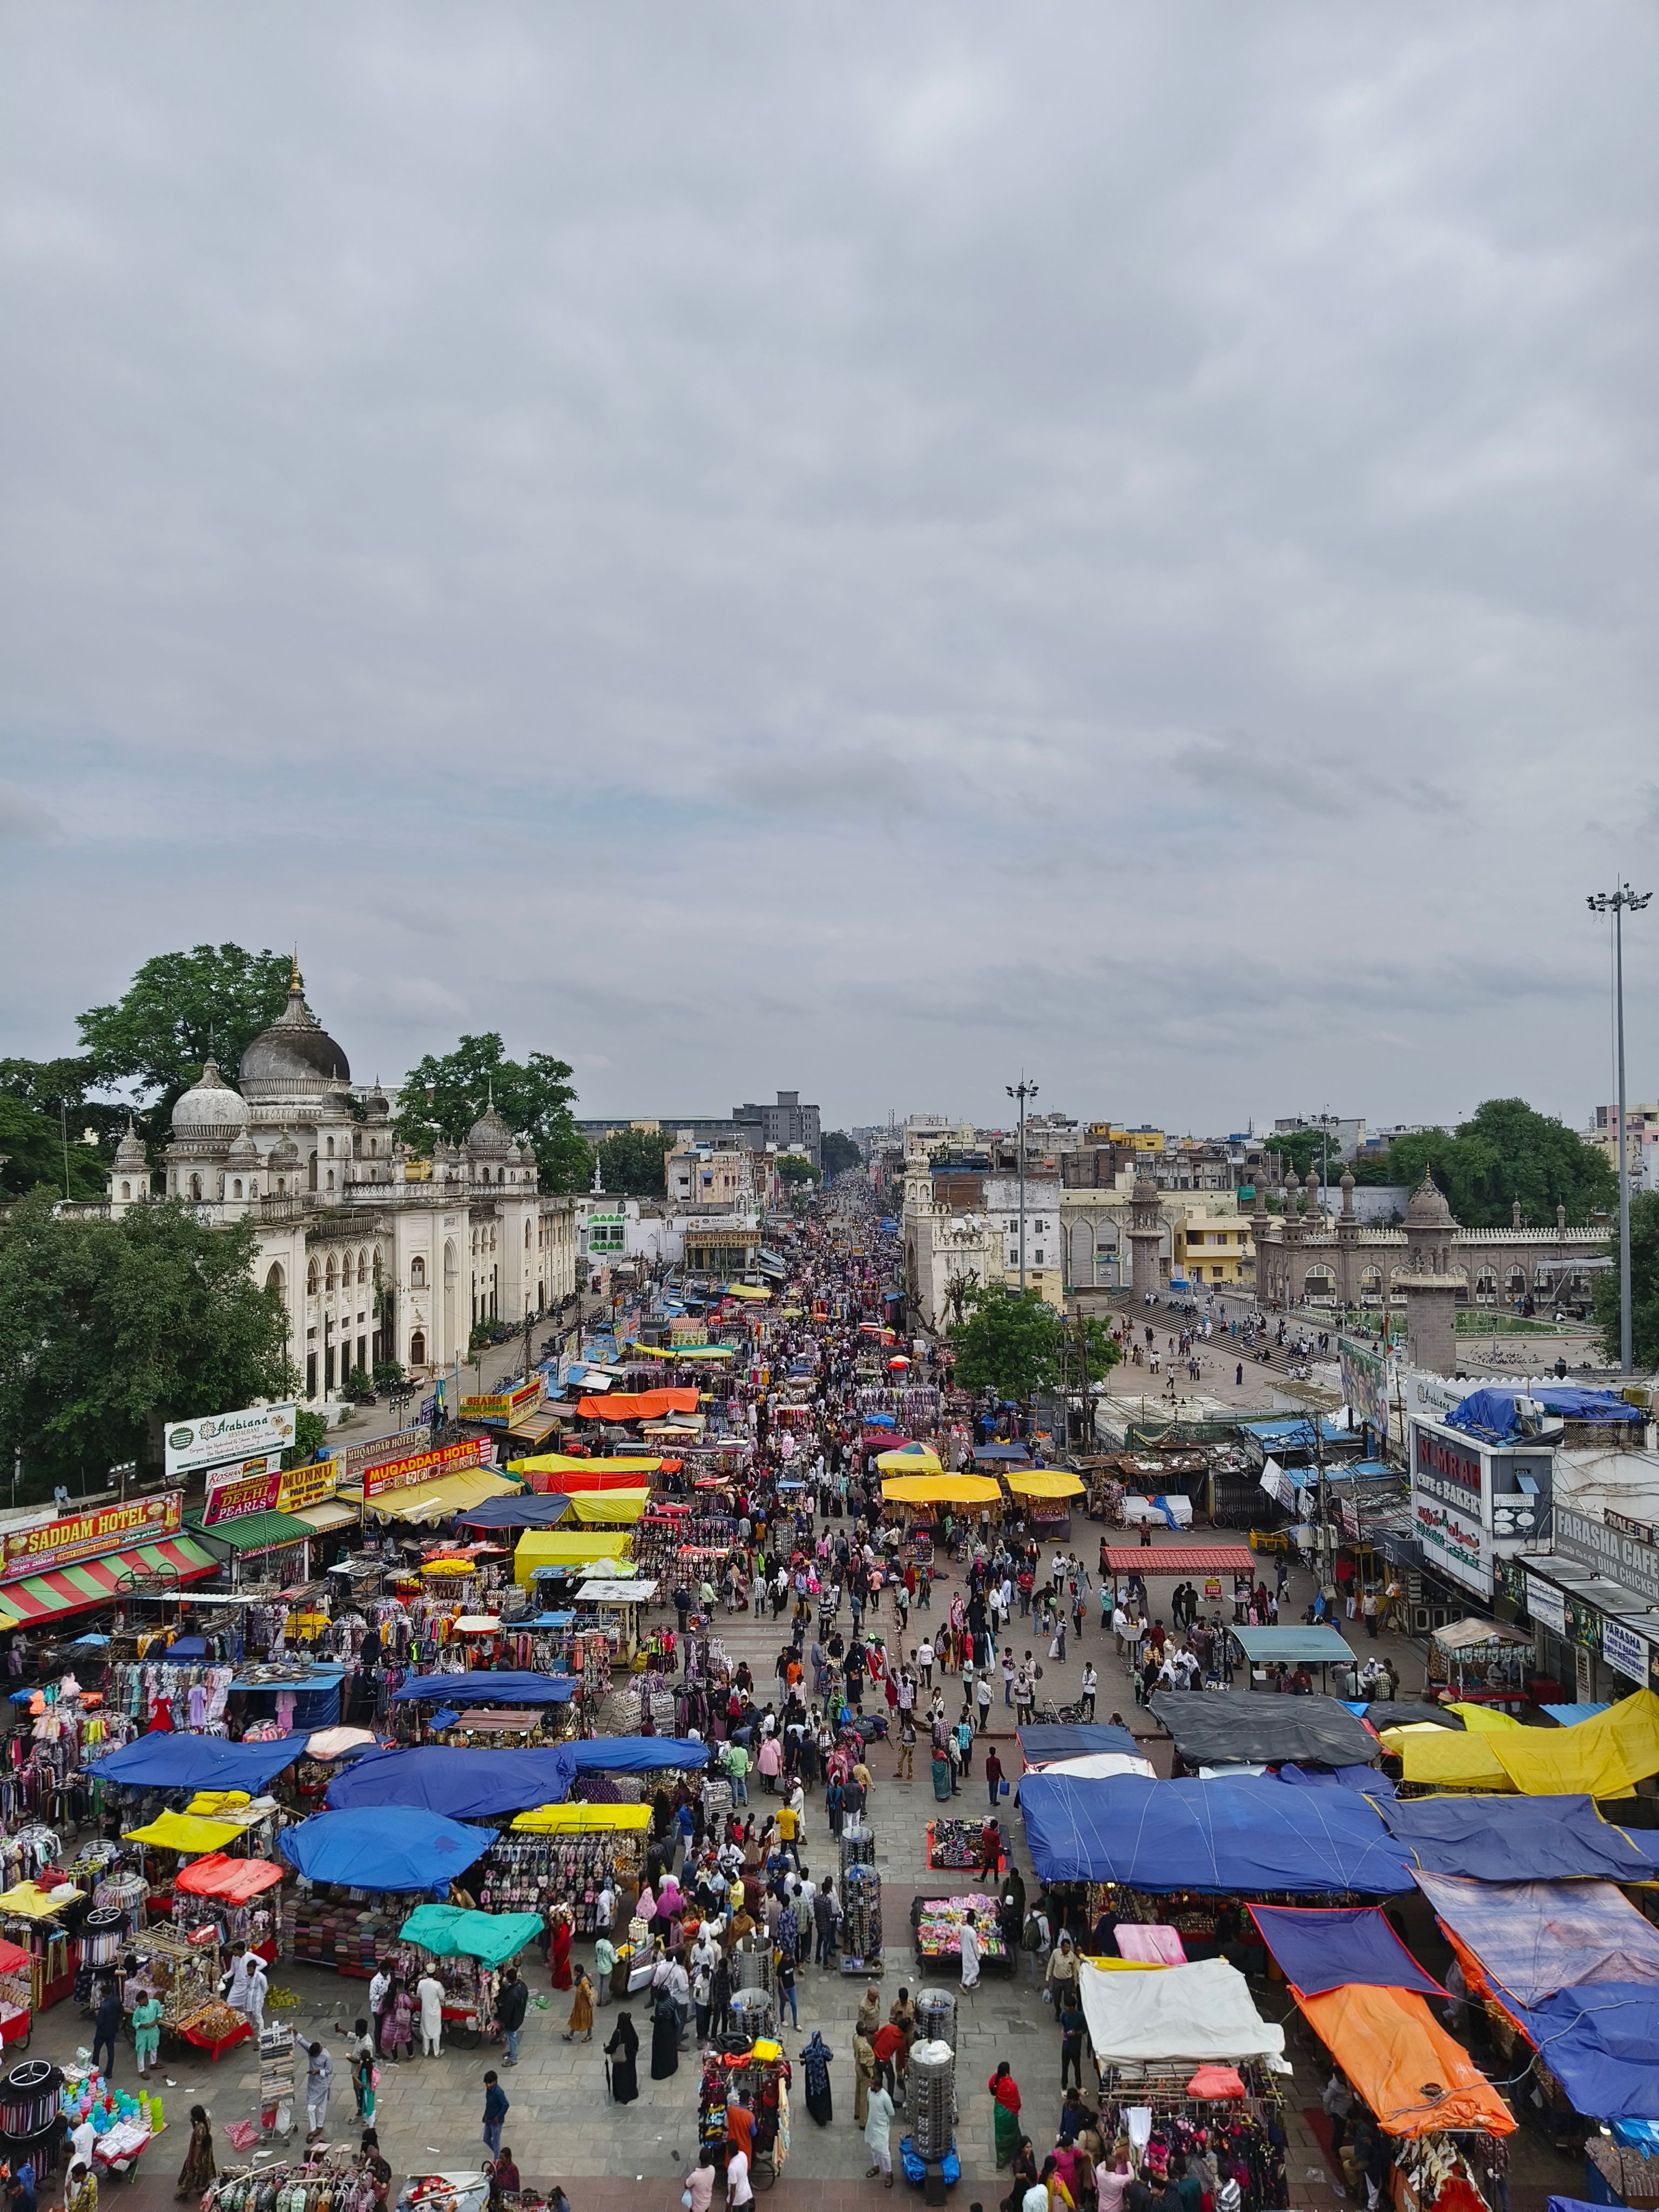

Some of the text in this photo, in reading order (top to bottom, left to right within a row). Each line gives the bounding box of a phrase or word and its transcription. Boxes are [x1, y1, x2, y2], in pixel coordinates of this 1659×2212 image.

[641, 1314, 663, 1323] MILAN
[466, 1396, 502, 1405] SHAMS
[1423, 1386, 1450, 1412] Arabiana
[211, 1417, 268, 1438] Arabiana
[228, 1427, 260, 1439] RESTAURANT
[347, 1441, 390, 1461] MUQADDAR
[392, 1434, 415, 1448] HOTEL
[369, 1452, 441, 1483] MUQADDAR
[443, 1442, 480, 1461] HOTEL
[1420, 1438, 1481, 1491] NIMRAH
[208, 1468, 242, 1486] ROSHAN
[282, 1463, 333, 1489] MUNNU
[220, 1486, 269, 1508] DELHI
[290, 1480, 325, 1498] PAN SHOP
[1417, 1473, 1437, 1493] CAFE
[1442, 1480, 1482, 1516] BAKERY
[218, 1498, 266, 1519] PEARLS
[29, 1506, 147, 1553] SADDAM HOTEL
[58, 1540, 118, 1560] FAMILY SECTION AVAILABLE
[1557, 1510, 1620, 1560] FARASHA
[1622, 1540, 1659, 1580] CAFE
[1597, 1555, 1659, 1599] DUM CHICKEN
[1605, 1622, 1642, 1651] FARASHA
[1623, 1644, 1640, 1661] BAKERY
